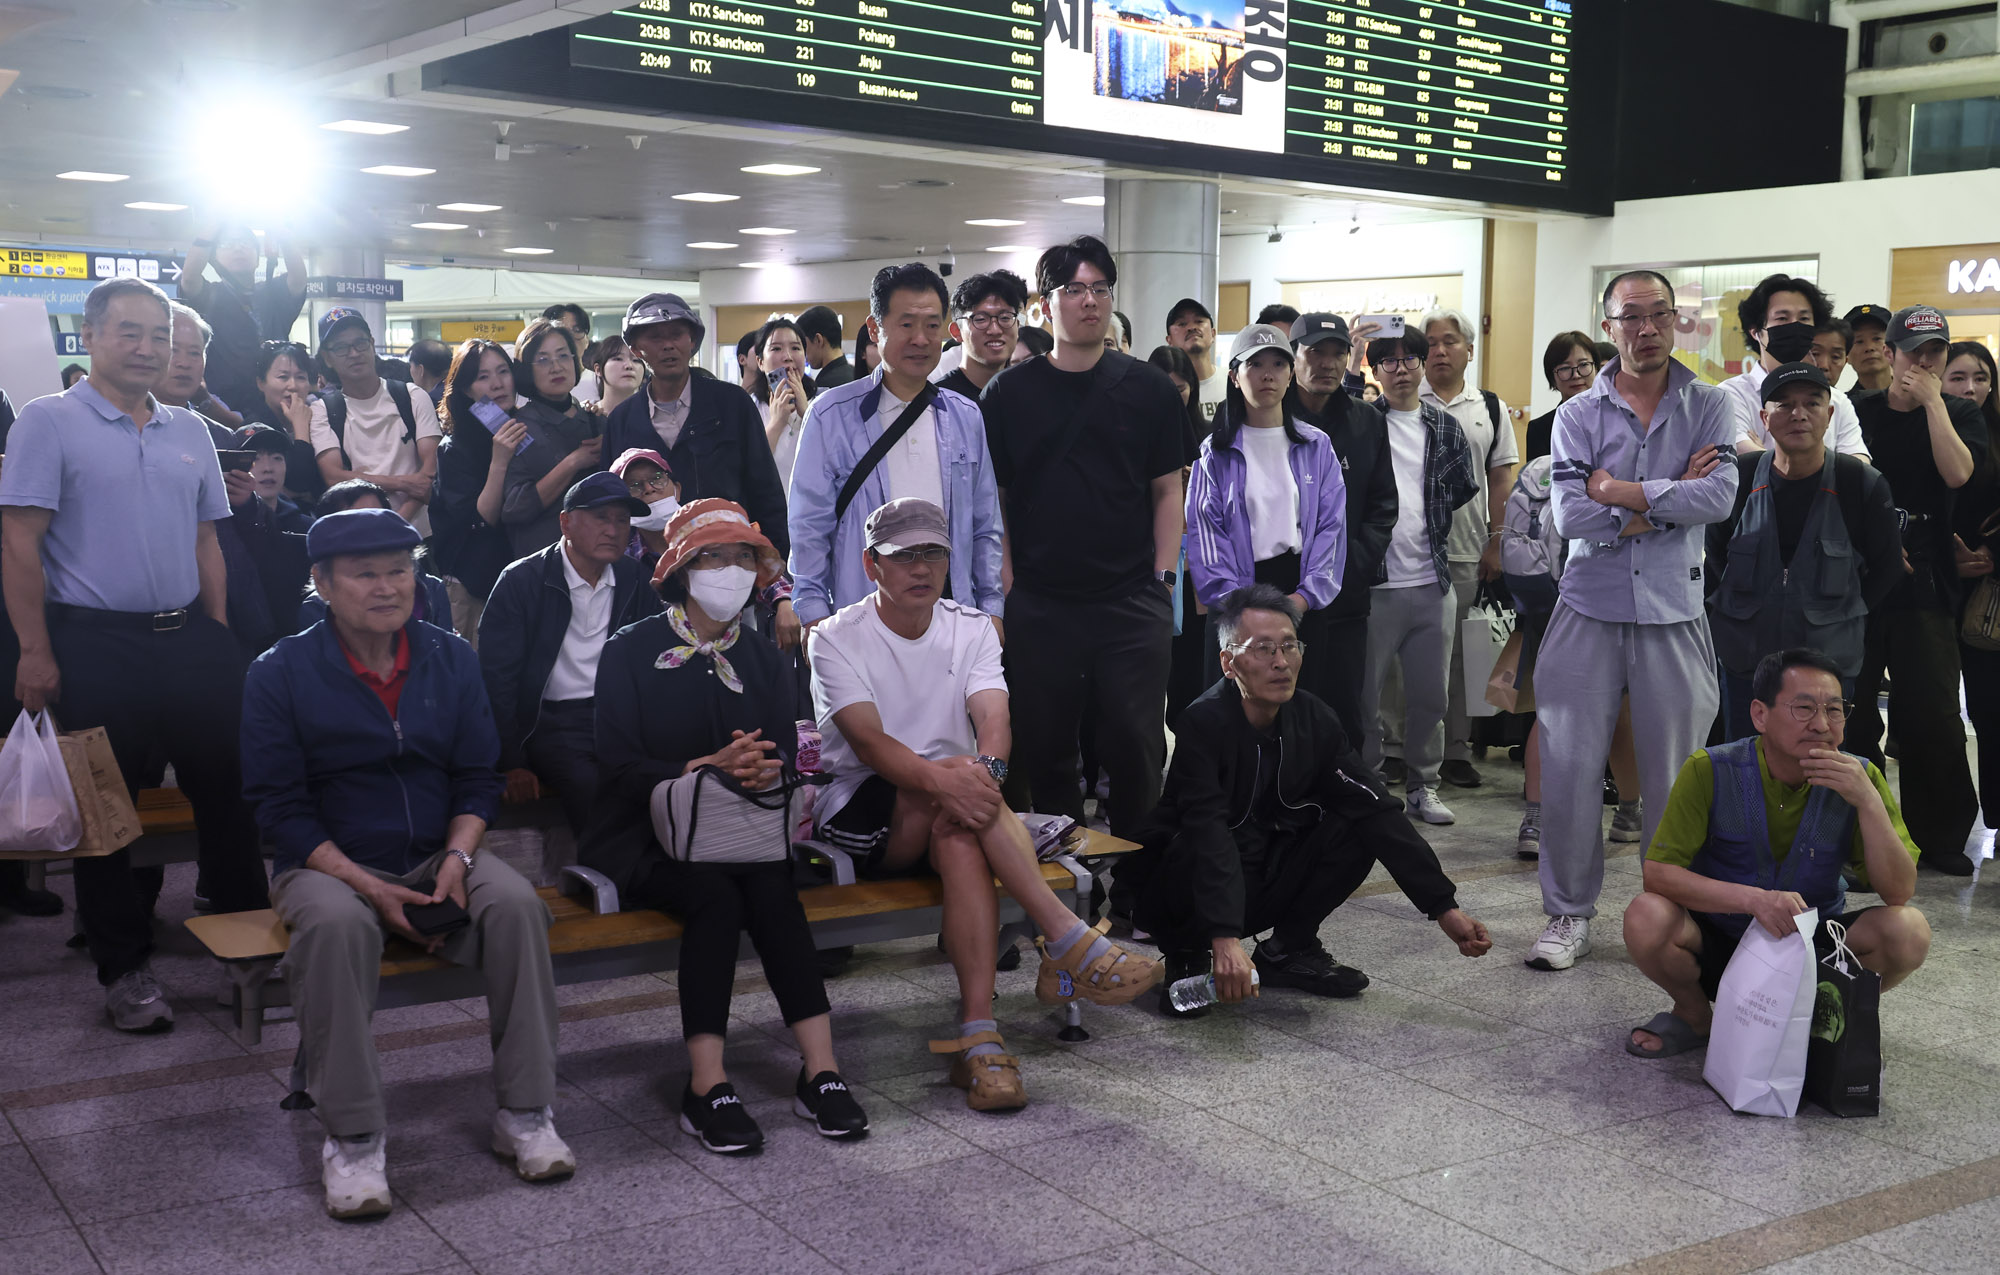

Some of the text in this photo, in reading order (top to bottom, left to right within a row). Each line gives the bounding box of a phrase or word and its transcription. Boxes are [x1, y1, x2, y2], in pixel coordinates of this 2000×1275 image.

[1012, 1, 1034, 16] 0min
[859, 1, 1034, 41] Busan 0min
[690, 2, 711, 18] KTX
[713, 6, 764, 26] Sancheon
[796, 19, 813, 33] 251
[859, 28, 895, 48] Pohang
[1011, 51, 1034, 66] 0min
[1355, 38, 1369, 50] KTX
[640, 24, 1034, 90] 20:38 KTX Sancheon 221 Jinju 0min
[1355, 59, 1368, 72] KTX
[640, 52, 671, 68] 20:49
[690, 58, 711, 74] KTX
[797, 73, 815, 87] 109
[859, 81, 887, 96] Busan
[1011, 101, 1034, 115] 0min
[336, 281, 395, 295] 열차도착안내
[1907, 316, 1942, 325] RELIABLE
[819, 1081, 847, 1095] FILA
[711, 1095, 741, 1110] FILA
